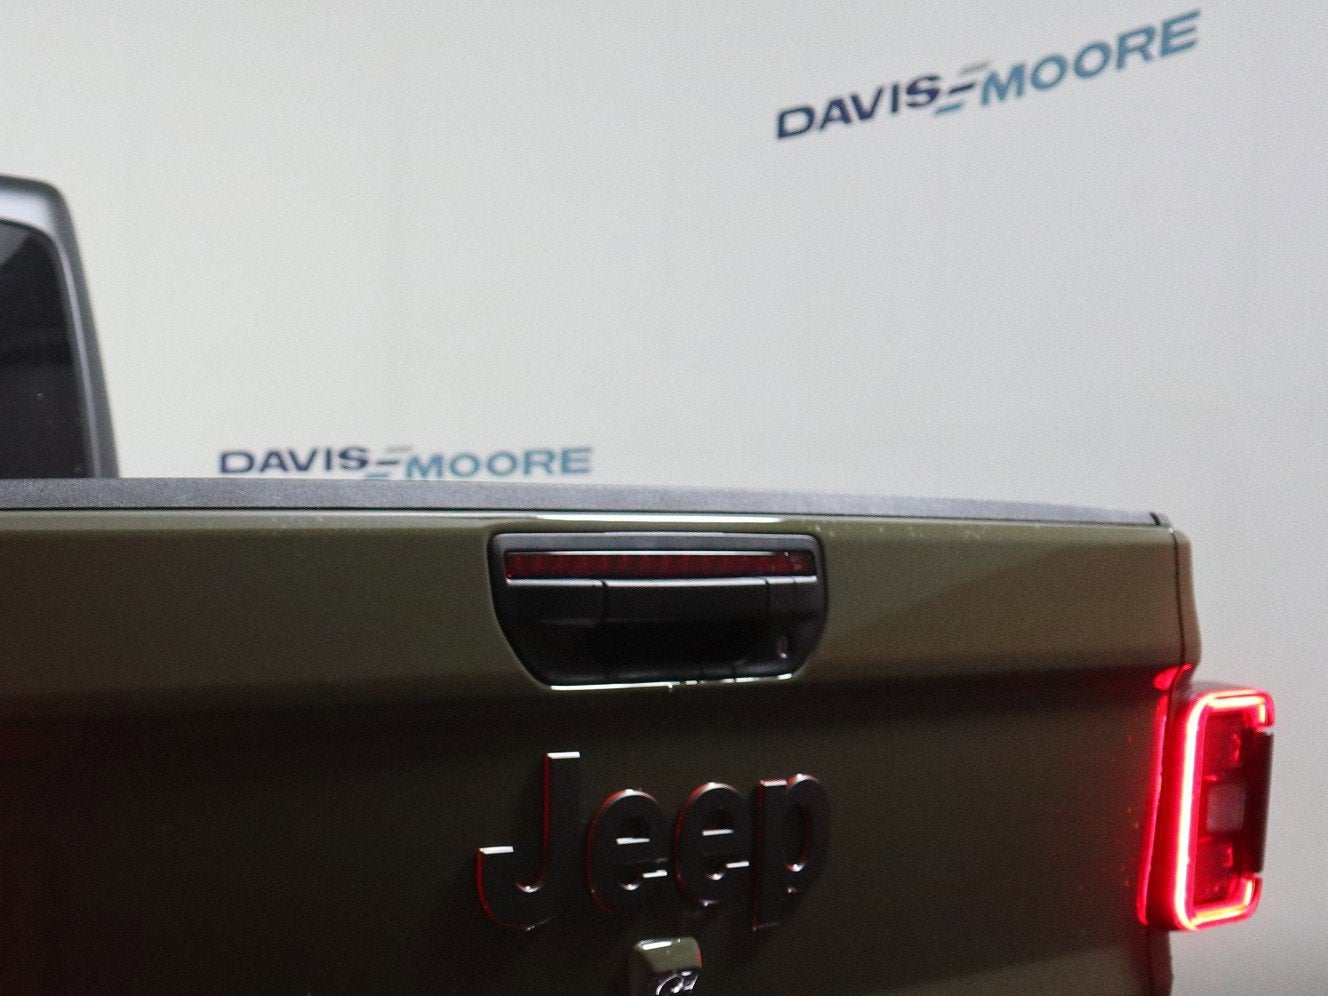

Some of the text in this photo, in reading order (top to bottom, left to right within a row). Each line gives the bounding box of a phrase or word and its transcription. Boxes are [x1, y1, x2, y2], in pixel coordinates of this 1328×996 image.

[775, 9, 1202, 141] DAVIS MOORE
[218, 446, 593, 479] DAVIS MOORE
[475, 751, 828, 931] Jeep
